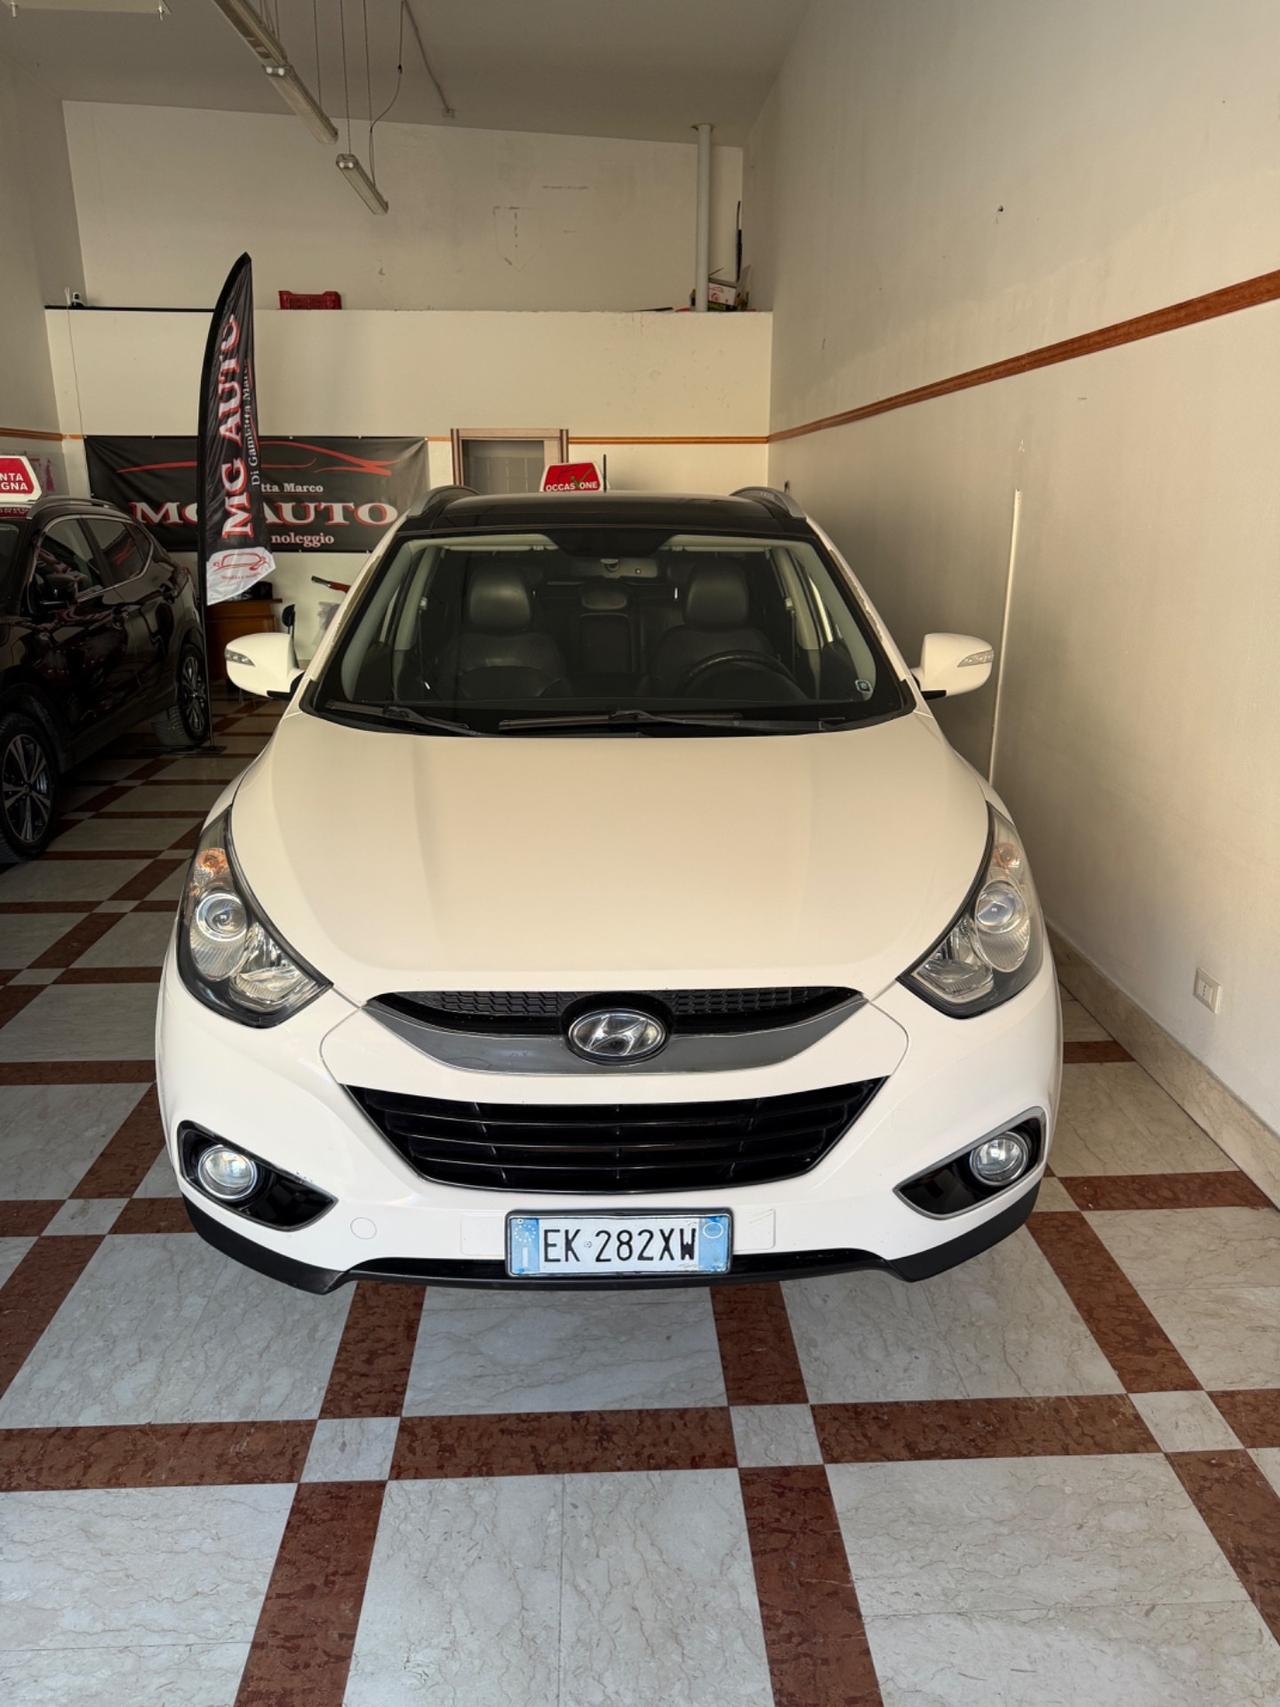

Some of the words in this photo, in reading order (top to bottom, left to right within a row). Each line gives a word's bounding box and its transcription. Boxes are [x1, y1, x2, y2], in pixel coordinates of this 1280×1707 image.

[1, 481, 29, 491] GNA
[251, 470, 260, 486] Di
[284, 483, 324, 493] Marco
[545, 481, 598, 492] OCCASONE
[222, 457, 254, 540] MG
[271, 532, 335, 548] noleggio
[543, 1228, 581, 1263] EK
[595, 1227, 697, 1263] 282XW
